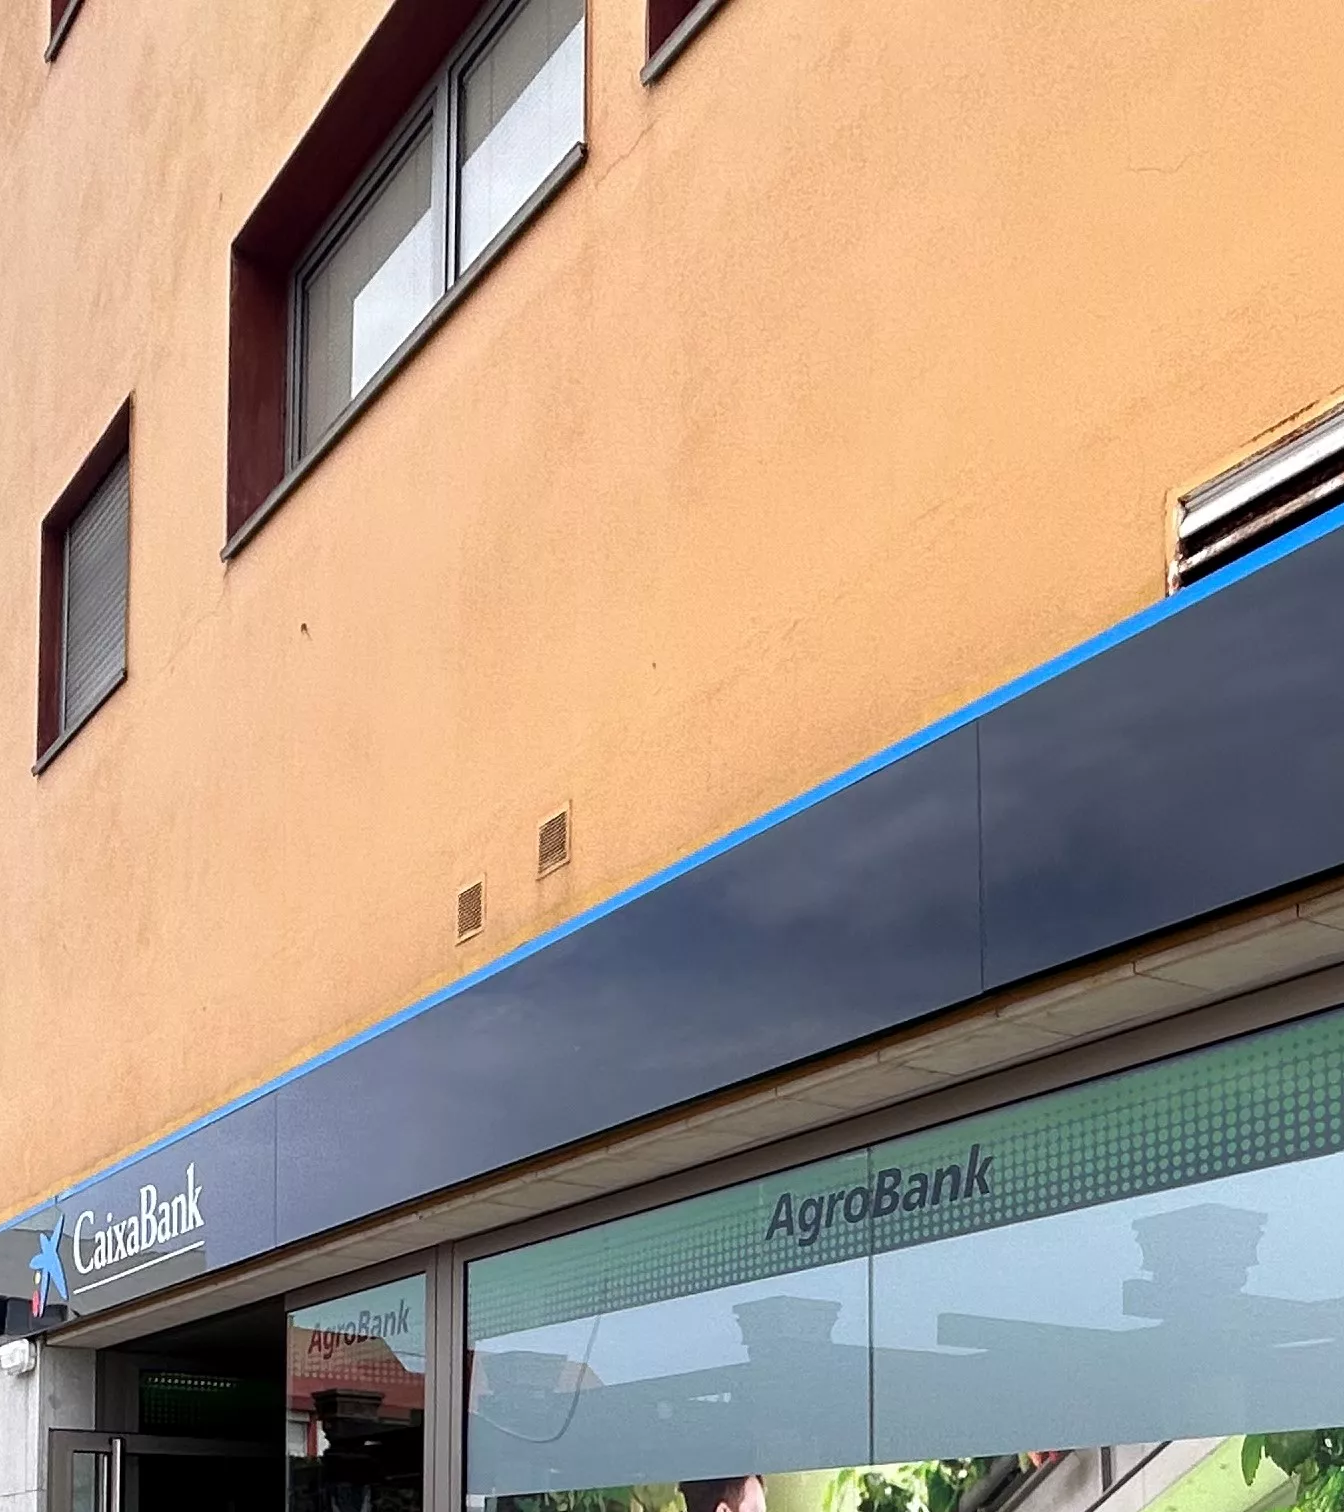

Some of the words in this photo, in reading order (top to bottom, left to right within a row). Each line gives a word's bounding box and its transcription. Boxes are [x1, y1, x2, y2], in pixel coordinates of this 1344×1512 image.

[73, 1162, 205, 1274] CaixaBank
[765, 1143, 994, 1247] AgroBank
[308, 1300, 410, 1360] AgroBank
